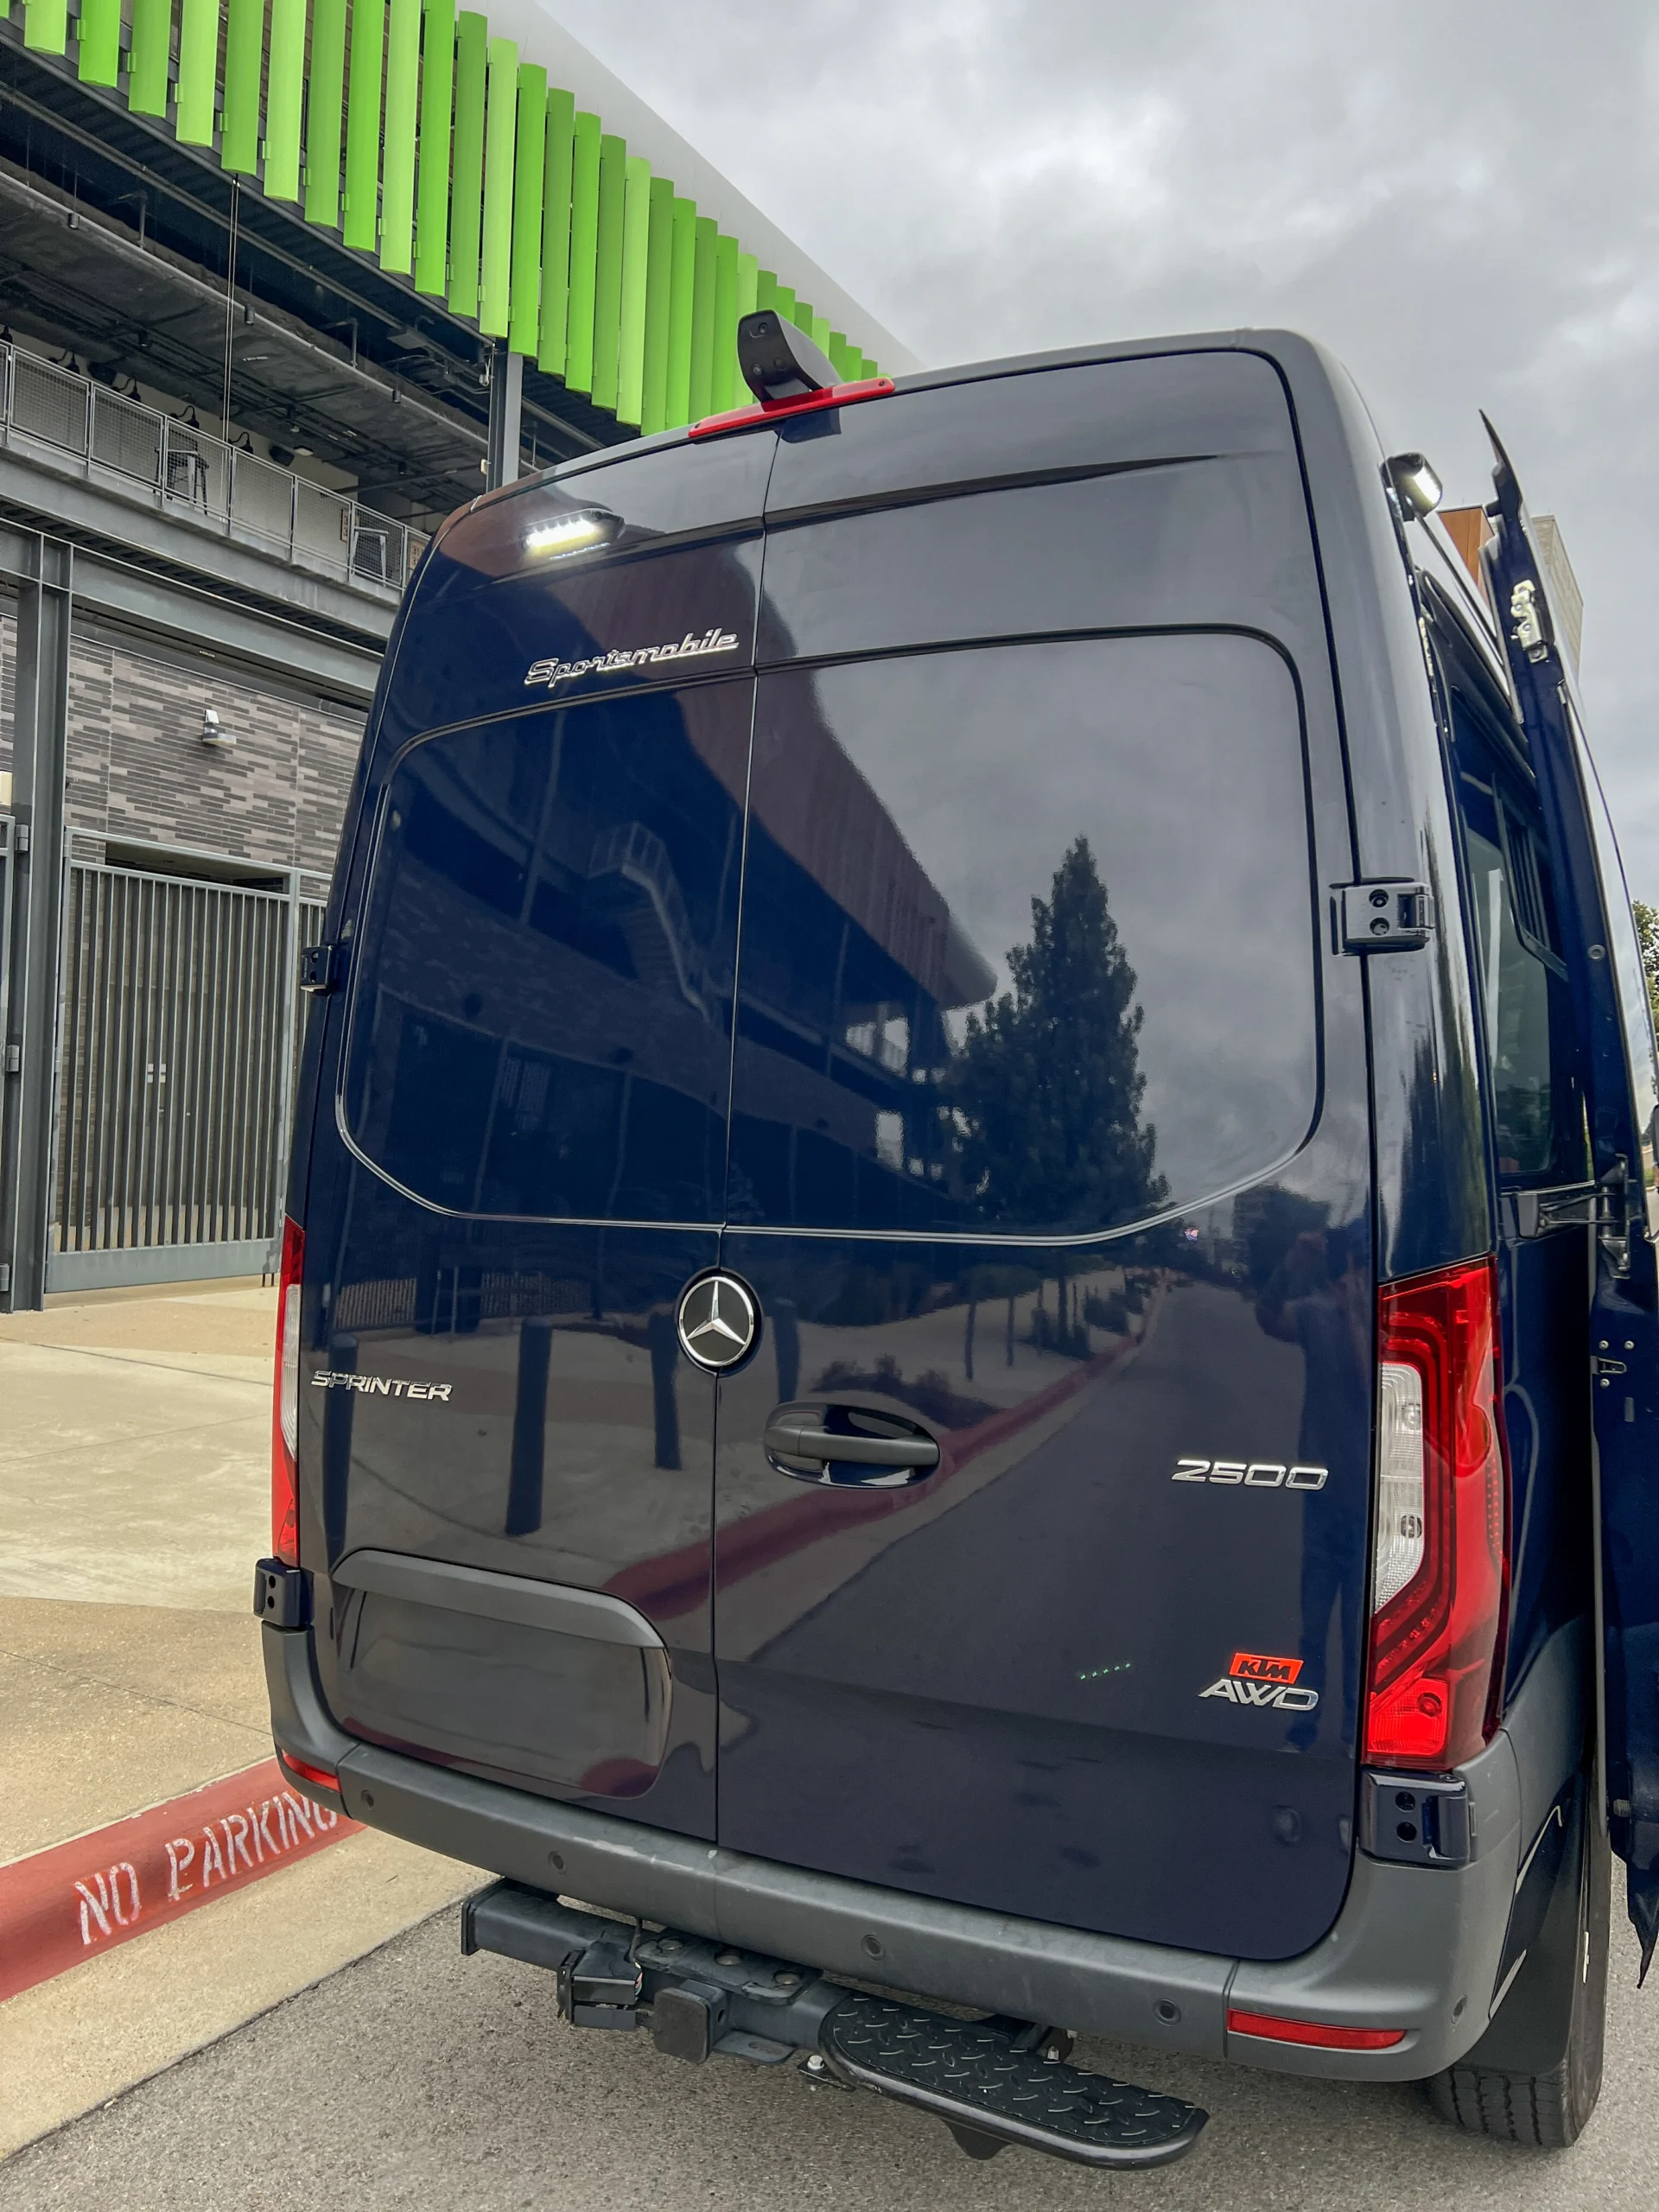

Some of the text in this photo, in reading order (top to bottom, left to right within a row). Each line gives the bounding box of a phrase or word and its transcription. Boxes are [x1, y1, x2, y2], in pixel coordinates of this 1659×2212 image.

[524, 627, 740, 688] Sportsmobile
[310, 1370, 454, 1402] SPRINTER
[1171, 1459, 1330, 1491] 2500
[1237, 1657, 1292, 1680] KTM
[1198, 1678, 1319, 1712] AWD
[74, 1790, 338, 1946] NO PARKING
